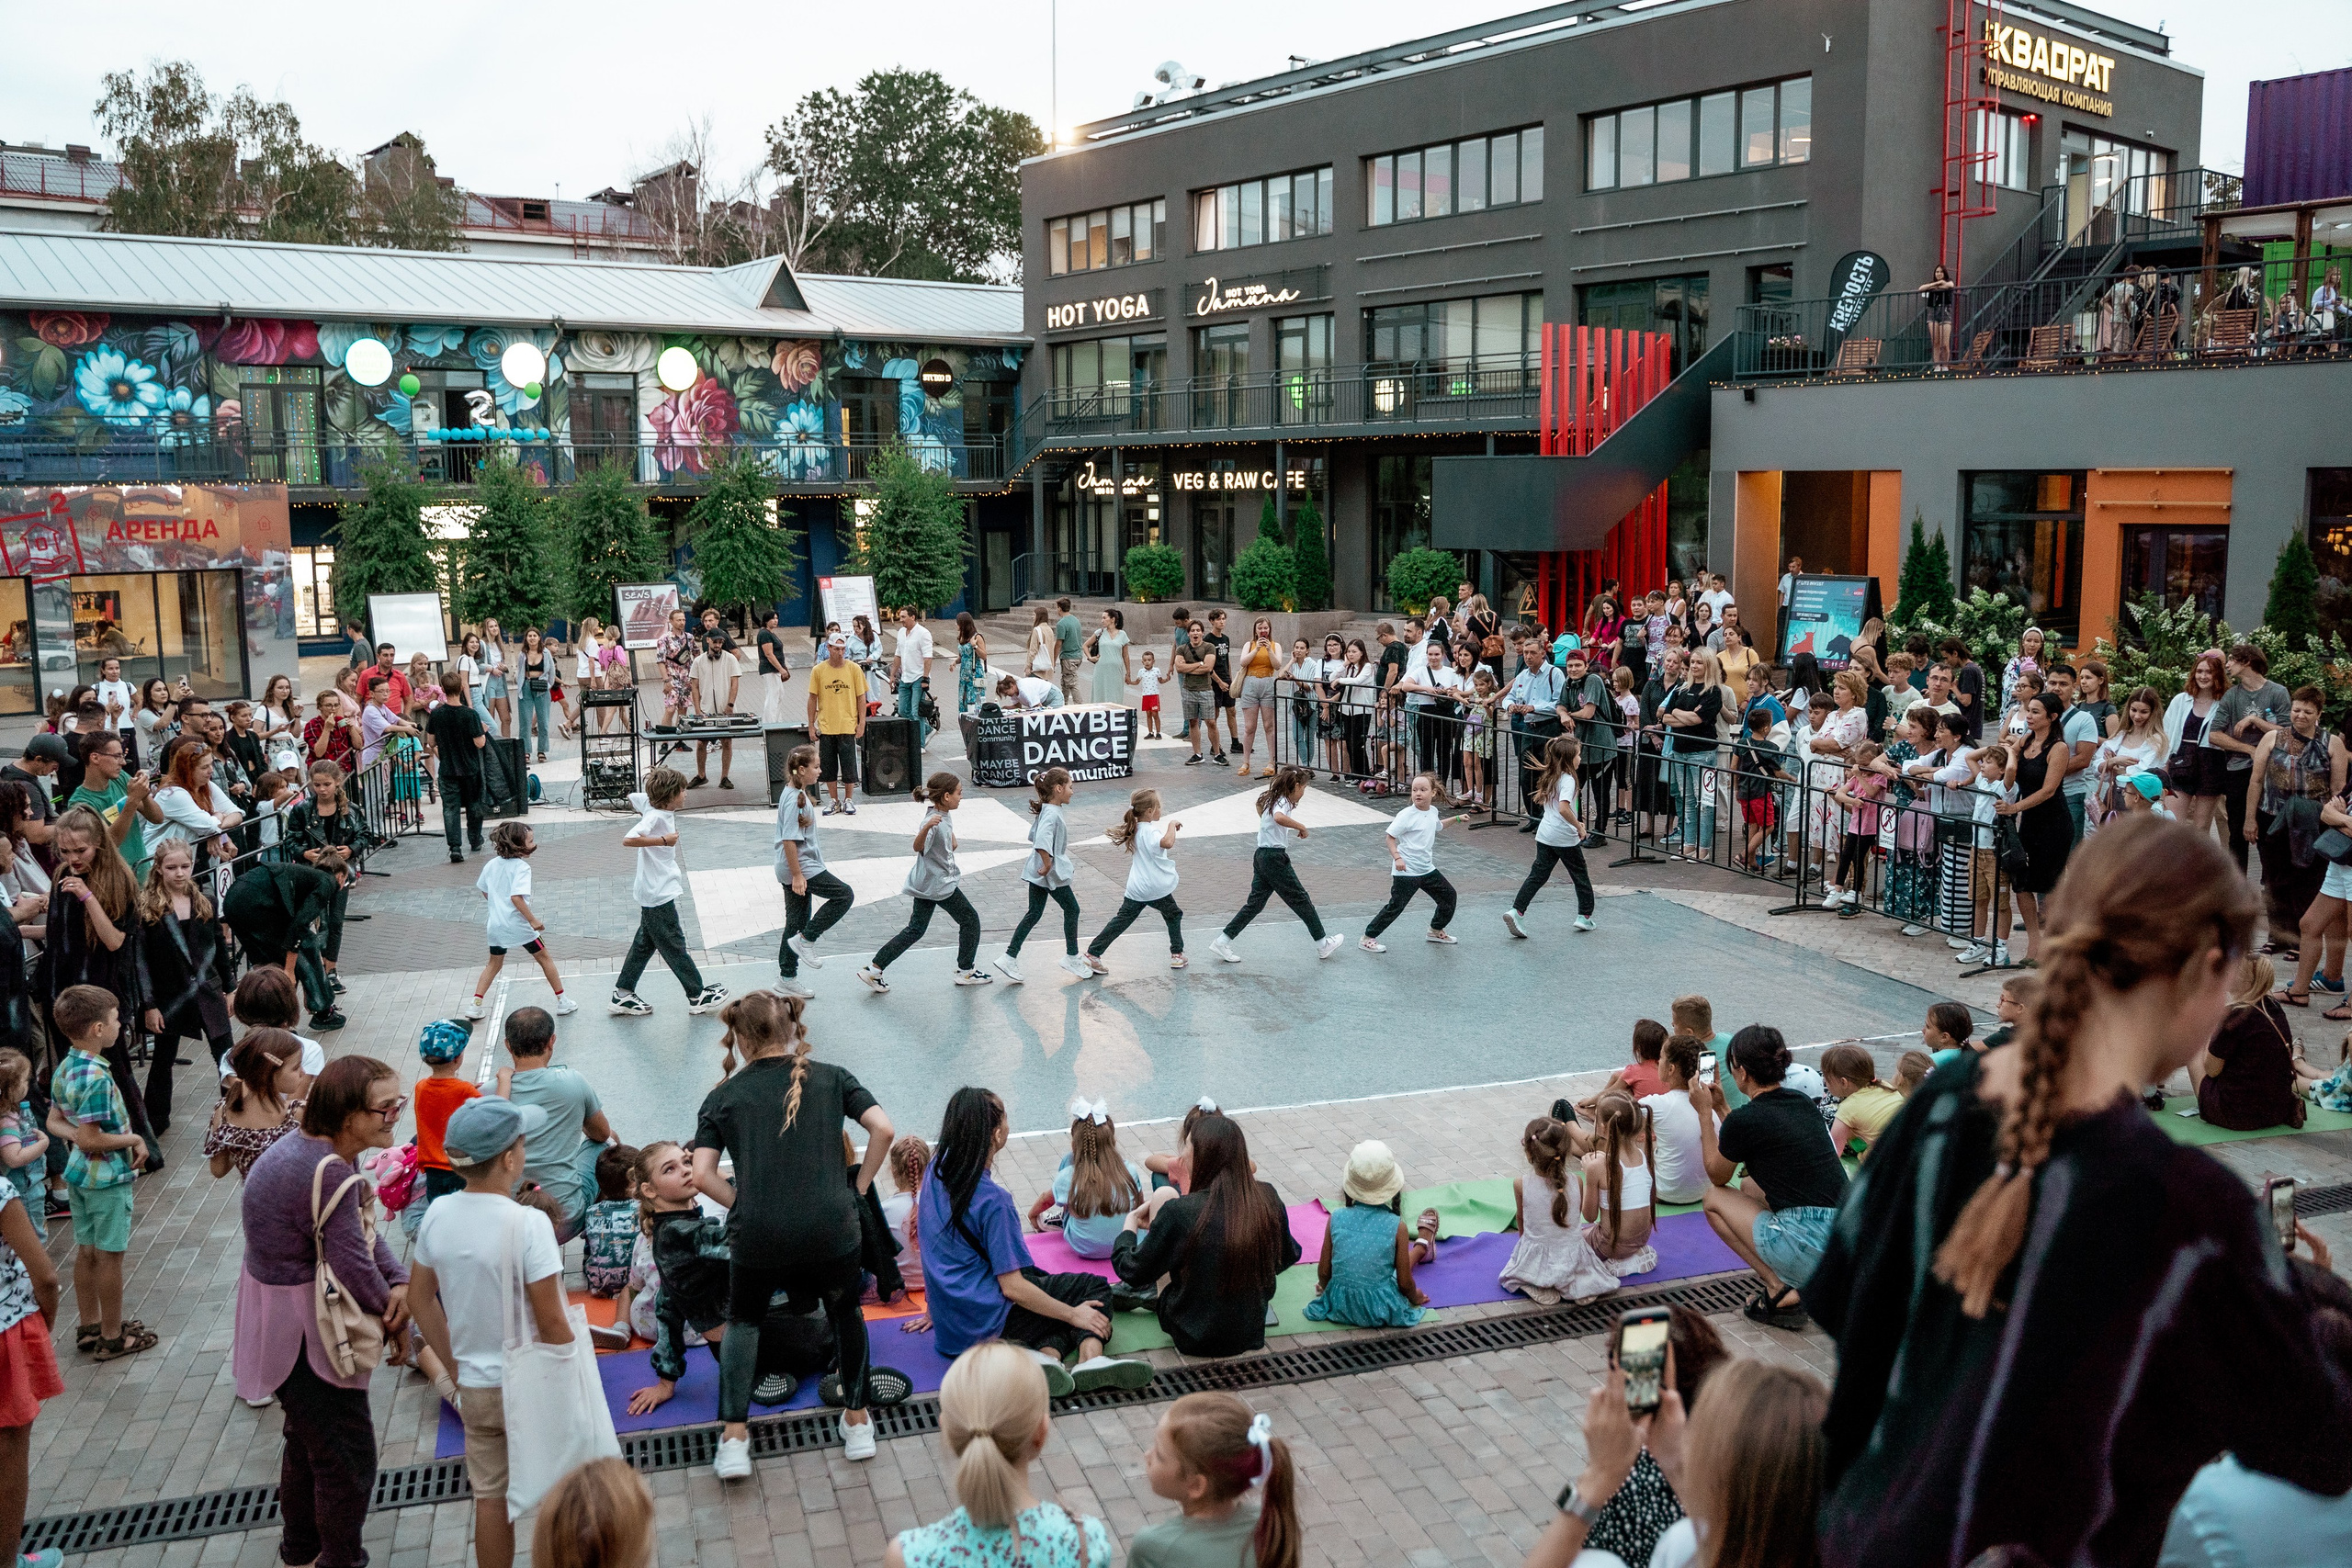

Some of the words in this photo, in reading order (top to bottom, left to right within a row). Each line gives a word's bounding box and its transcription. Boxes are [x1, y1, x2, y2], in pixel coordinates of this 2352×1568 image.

[2063, 89, 2112, 117] КОМПАНИЯ
[1197, 276, 1301, 316] Jamuna
[1225, 288, 1243, 299] HOT
[1244, 284, 1267, 295] YOGA
[1829, 255, 1874, 332] КРЕПОСТЬ
[1047, 302, 1086, 329] HOT
[1091, 294, 1149, 321] YOGA
[1078, 461, 1154, 489] Jamna
[1173, 472, 1204, 490] VEG
[1208, 472, 1219, 490] &
[1224, 471, 1259, 490] RAW
[107, 519, 220, 543] АРЕНДА
[625, 590, 650, 600] SENS
[978, 724, 1016, 735] DANCE
[1023, 709, 1128, 737] MAYBE
[978, 735, 1017, 743] Community
[1023, 736, 1128, 765] DANCE
[979, 758, 1020, 769] MAYBE
[981, 769, 1021, 779] DANCE
[1026, 762, 1128, 785] Cmunity
